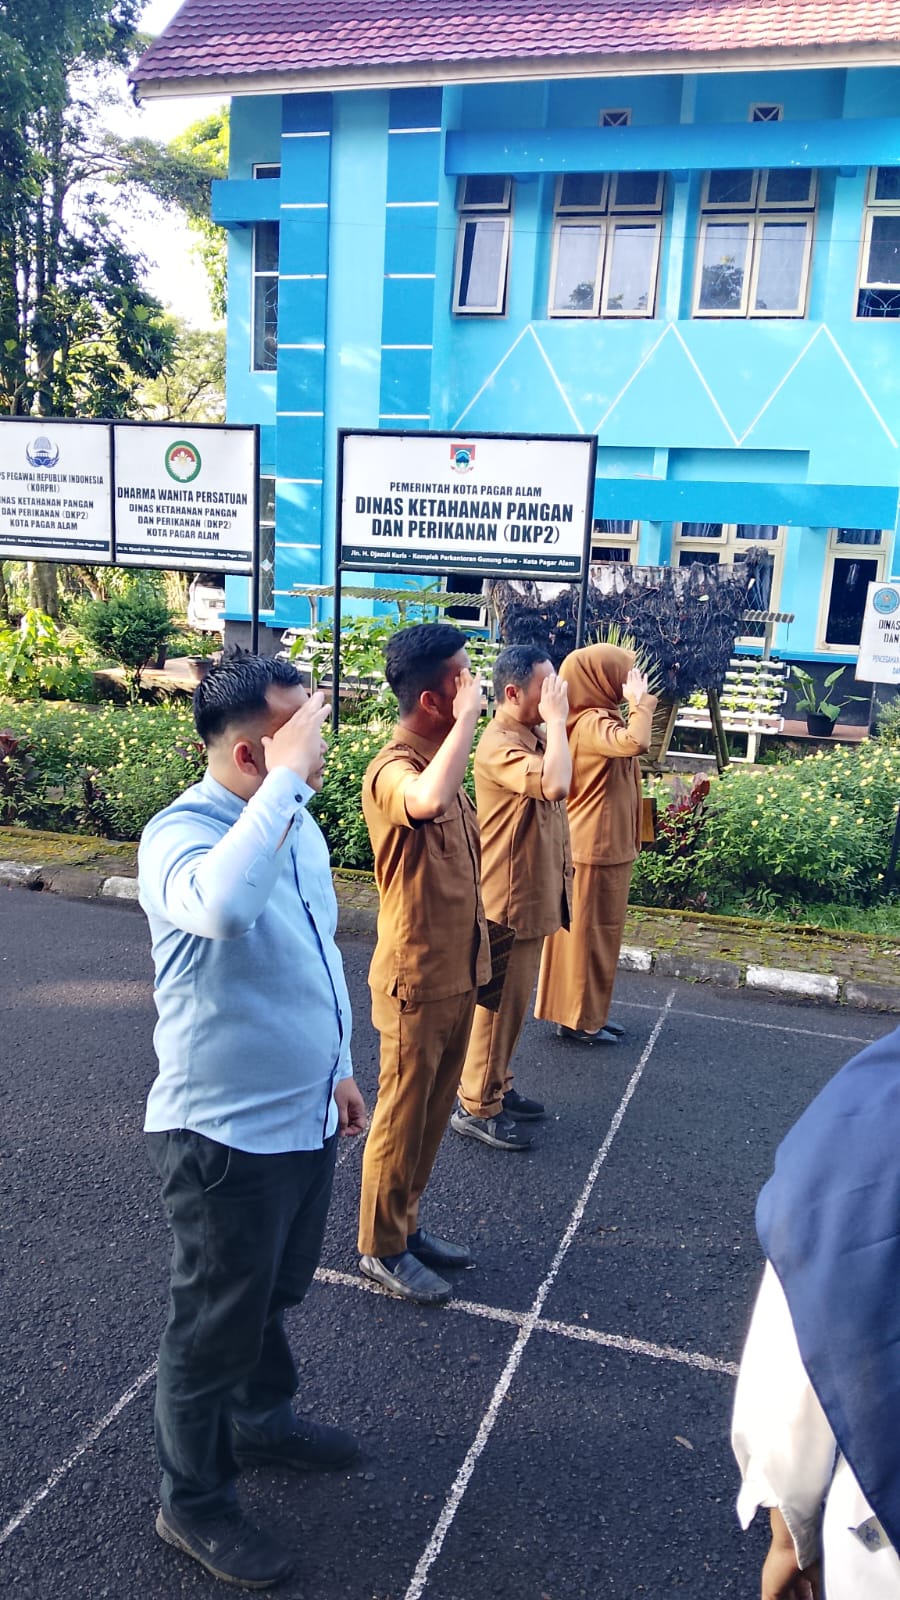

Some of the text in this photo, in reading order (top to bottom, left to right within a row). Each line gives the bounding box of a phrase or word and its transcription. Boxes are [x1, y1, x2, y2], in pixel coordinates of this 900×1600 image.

[7, 472, 36, 481] PEGAWAI
[37, 473, 67, 483] REPUBLIK
[69, 475, 104, 484] INDONESIA
[26, 483, 60, 493] (KORPRI)
[389, 481, 542, 497] PEMERINTAH KOTA PAGAR ALAM
[117, 486, 248, 505] DHARMA WANITA PERSATUAN
[18, 497, 61, 507] KETAHANAN
[63, 499, 94, 509] PANGAN
[355, 496, 573, 522] DINAS KETAHANAN PANGAN
[2, 507, 88, 520] DAN PERIKANAN (DKP2)
[129, 503, 237, 518] DINAS KETAHANAN PANGAN
[10, 519, 78, 530] KOTA PAGAR ALAM
[138, 515, 232, 530] DAN PERIKANAN (DKP2)
[146, 528, 220, 541] KOTA PAGAR ALAM
[371, 518, 560, 544] DAN PERIKANAN (DKP2)
[539, 558, 557, 567] Pagar
[558, 559, 575, 567] Alam
[878, 619, 900, 630] DINAS
[883, 632, 899, 643] DAN
